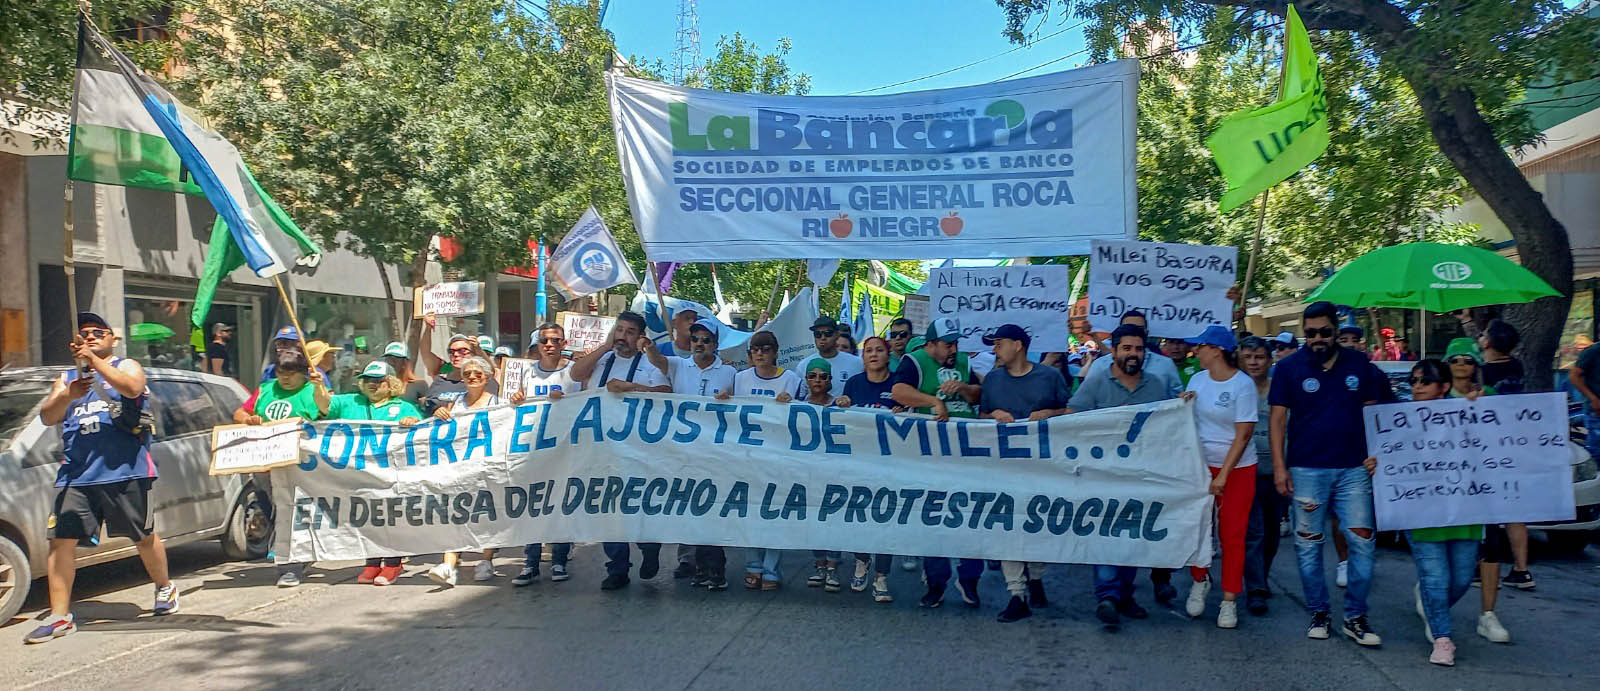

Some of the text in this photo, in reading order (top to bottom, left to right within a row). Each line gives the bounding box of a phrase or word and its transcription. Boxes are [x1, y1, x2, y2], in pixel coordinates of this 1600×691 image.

[668, 99, 1073, 150] La Bancaria
[673, 153, 1074, 174] SOCIEDAD DE EMPLEADOS DE BANCO
[679, 181, 1075, 212] SECCIONAL GENERAL ROCA
[937, 271, 958, 288] AL
[938, 292, 1006, 314] CASTA
[572, 317, 586, 329] NO
[79, 415, 101, 435] 30
[1516, 408, 1542, 422] no
[297, 411, 494, 471] CONTRA
[509, 403, 558, 454] EL
[570, 396, 764, 447] AJUSTE
[788, 405, 852, 455] DE
[1381, 441, 1403, 454] se
[1499, 437, 1528, 447] no
[1483, 457, 1517, 469] se
[294, 477, 1169, 542] EN DEFENSA DEL DERECHO A LA PROTESTA SOCIAL
